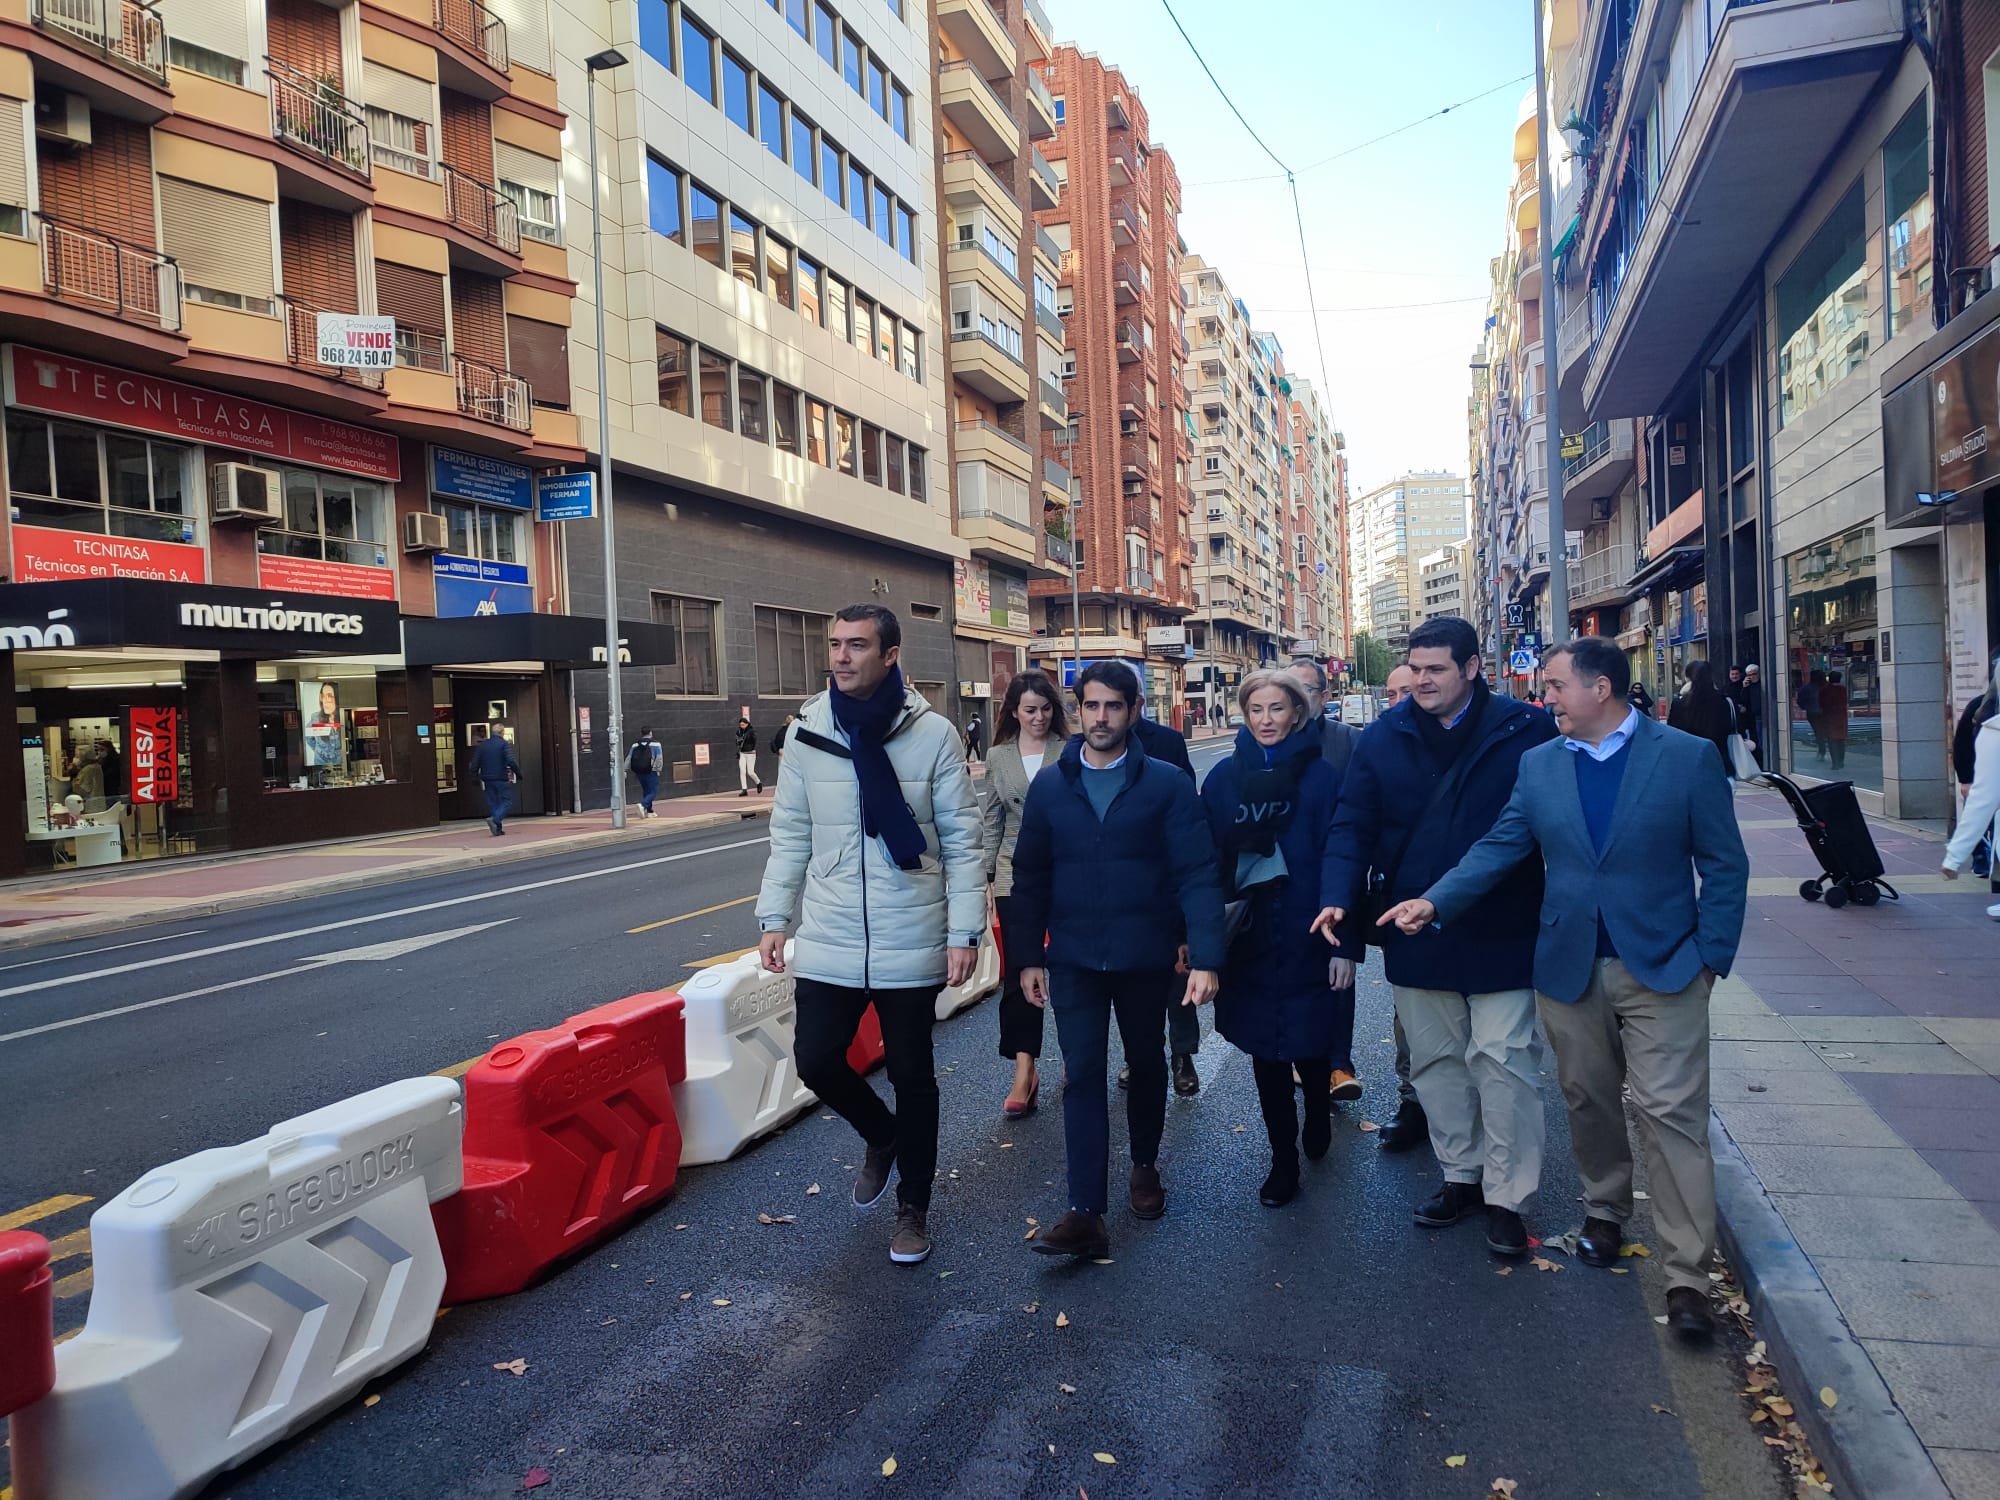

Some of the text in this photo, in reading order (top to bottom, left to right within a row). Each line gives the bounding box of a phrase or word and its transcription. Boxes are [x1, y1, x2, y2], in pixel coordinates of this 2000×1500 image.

[346, 331, 392, 349] VENDE
[321, 347, 392, 366] 968 24 50 47
[66, 367, 273, 436] TECNITASA
[176, 418, 274, 448] Técnicos en tasaciones
[1964, 433, 1985, 454] STUDIO
[303, 436, 387, 461] murcia@tecnitasa.es
[320, 453, 388, 474] www.tecnitasa.es
[438, 449, 477, 468] FERMAR
[478, 459, 528, 480] GESTIONES
[540, 480, 590, 490] INMOBILIARIA
[550, 490, 580, 499] FERMAR
[73, 540, 150, 561] TECNITASA
[25, 554, 193, 583] Técnicos en Tasación S.A.
[474, 600, 498, 616] AXA
[237, 1132, 416, 1244] SAFEBLOCK
